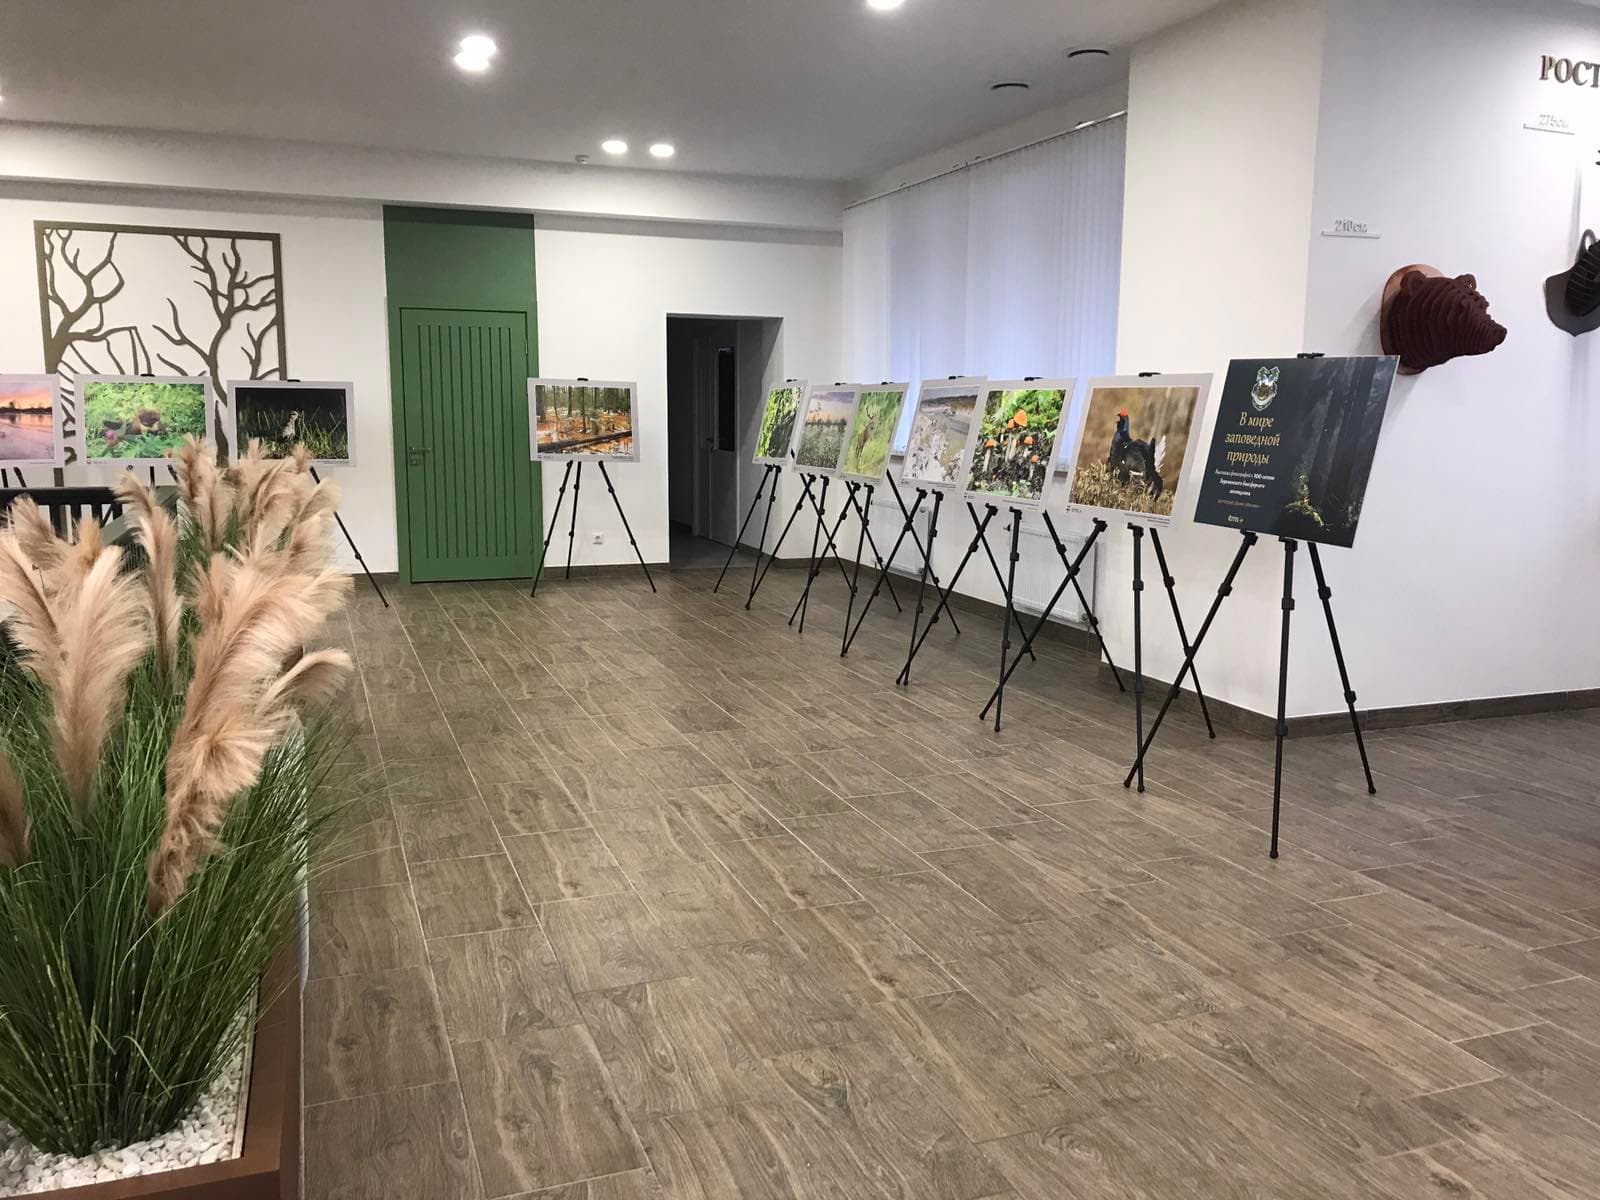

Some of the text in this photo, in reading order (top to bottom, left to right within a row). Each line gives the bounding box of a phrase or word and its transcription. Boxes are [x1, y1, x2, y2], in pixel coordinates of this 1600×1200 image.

[1539, 55, 1600, 88] РОСТ
[1240, 411, 1274, 432] В мире
[1224, 433, 1281, 448] заповедной
[1227, 451, 1270, 467] природы
